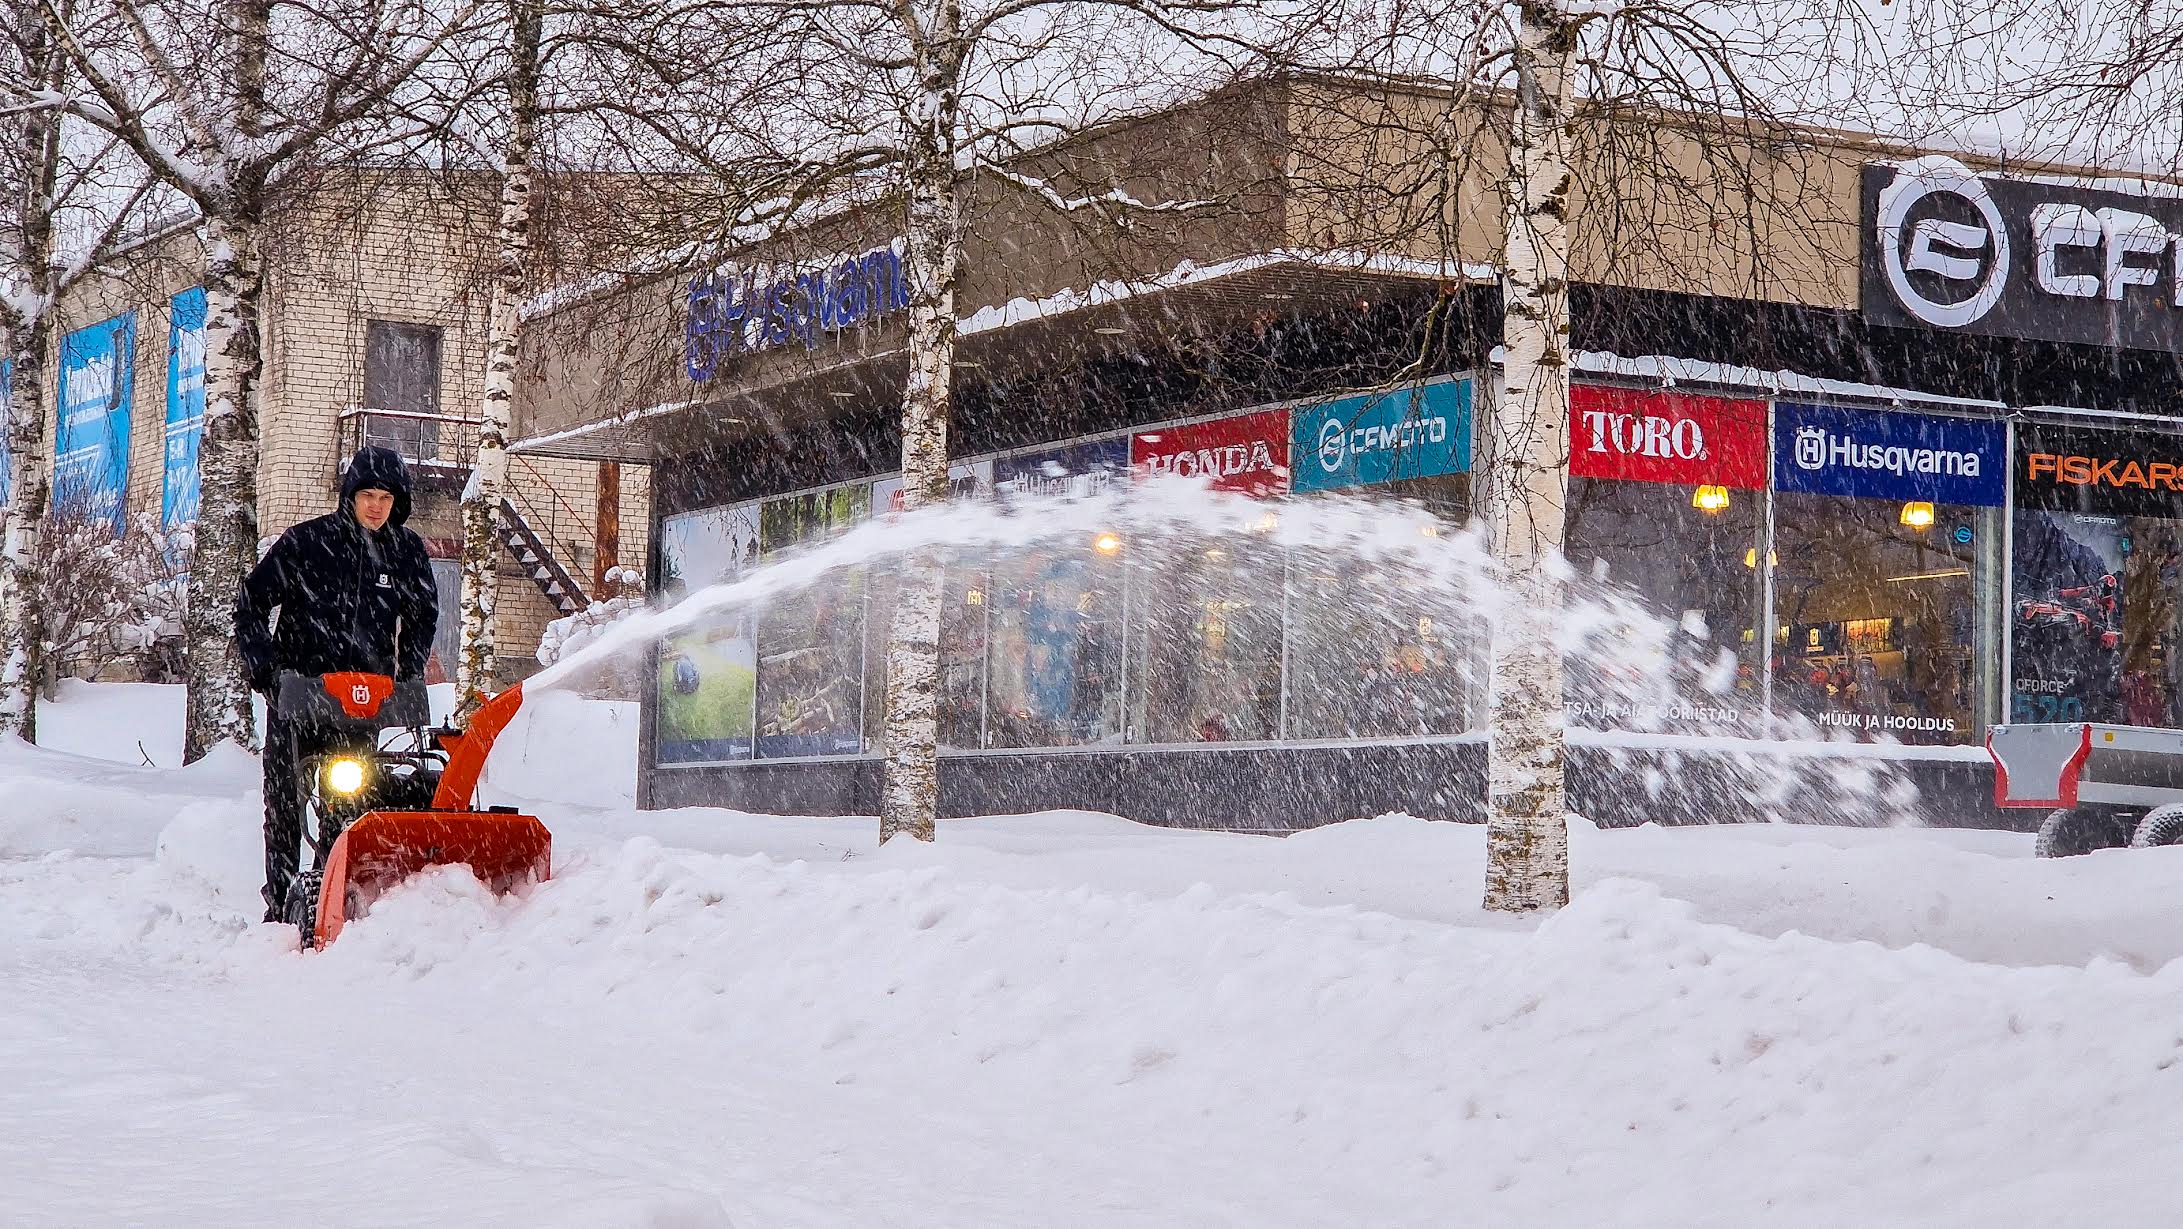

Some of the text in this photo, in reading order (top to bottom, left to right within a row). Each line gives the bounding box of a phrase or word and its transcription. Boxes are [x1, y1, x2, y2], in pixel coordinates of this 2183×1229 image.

[2031, 204, 2183, 307] CF
[1351, 416, 1446, 455] CFMOTO
[1582, 410, 1704, 460] TORO
[1147, 440, 1275, 479] HONDA
[1829, 435, 1981, 477] Husqvarna
[1819, 710, 1955, 732] MÜÜK JA HOOLDUS
